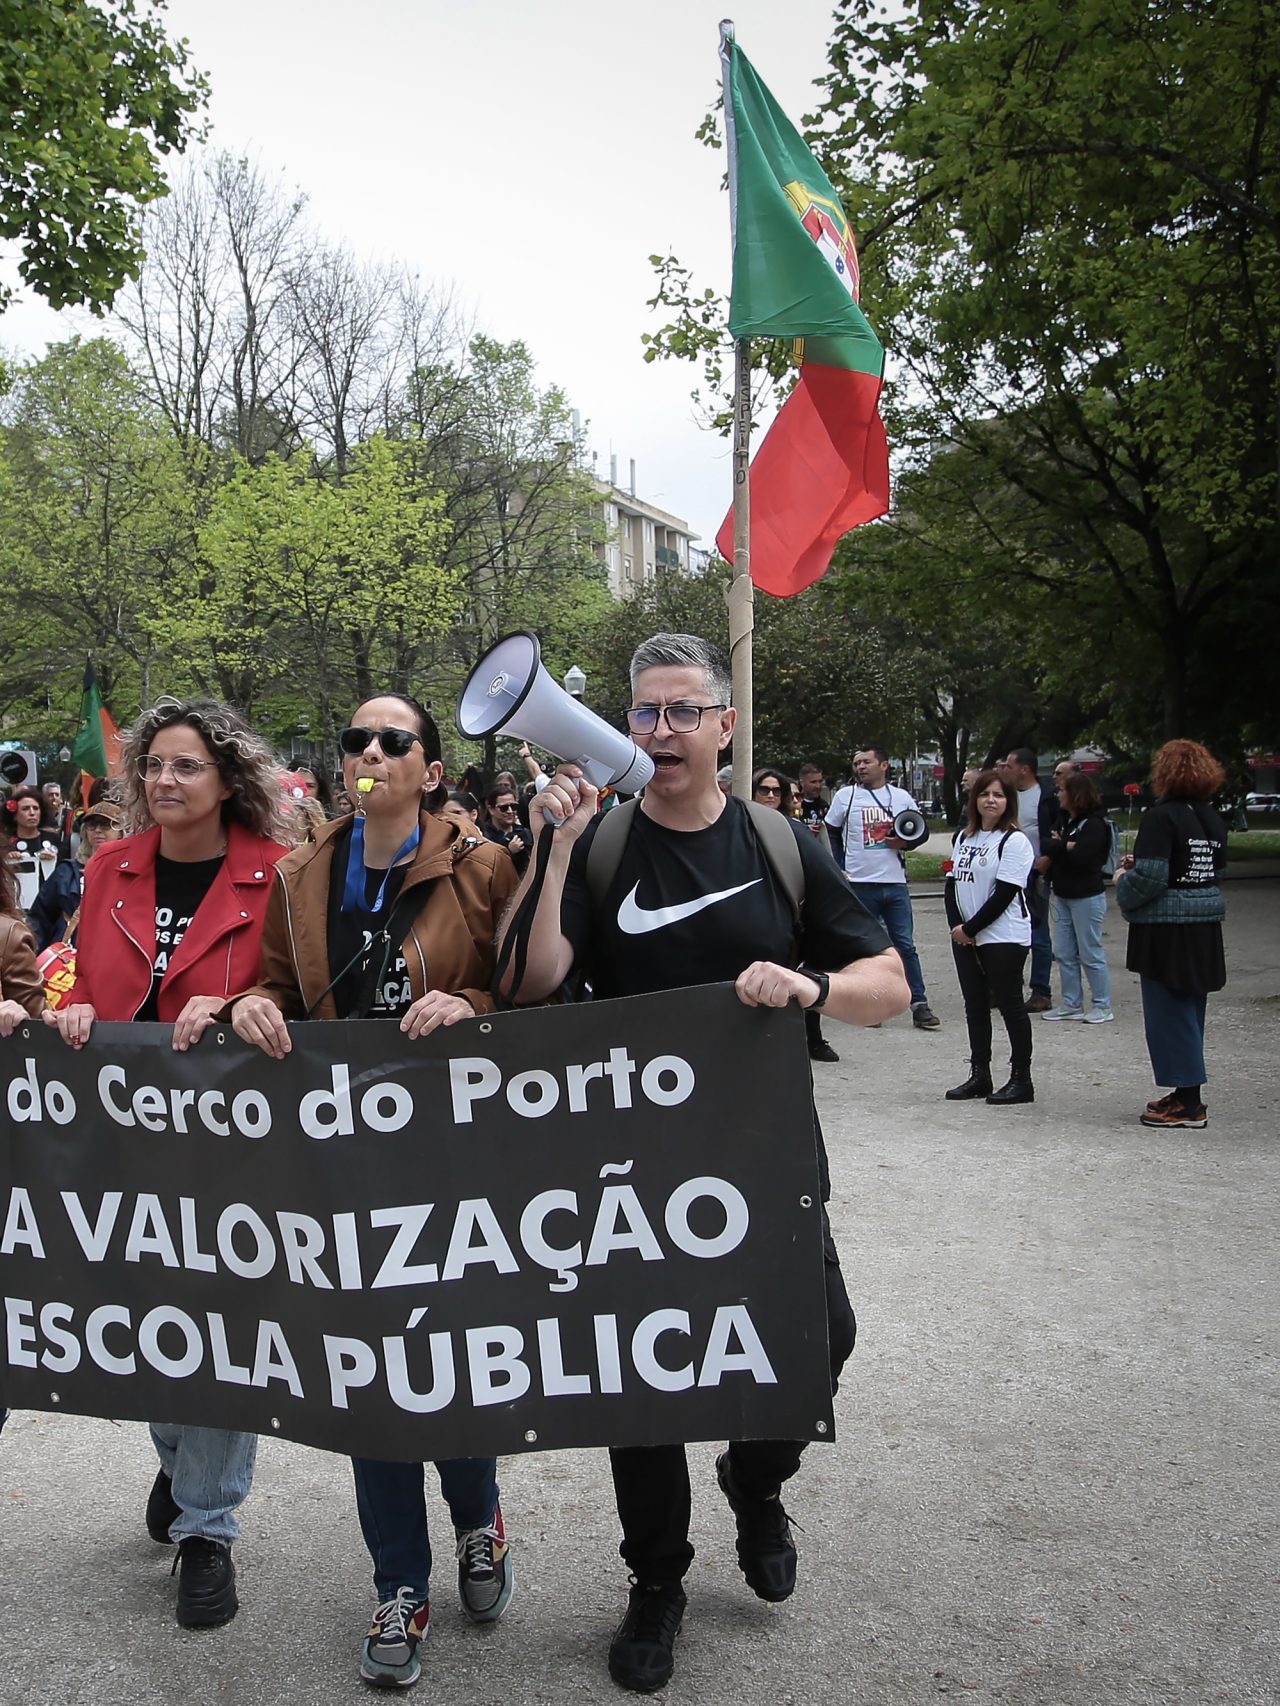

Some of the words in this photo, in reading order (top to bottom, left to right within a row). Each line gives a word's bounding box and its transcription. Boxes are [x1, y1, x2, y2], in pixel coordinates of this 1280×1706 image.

[7, 1057, 77, 1125] do
[97, 1064, 272, 1139] Cerco
[298, 1063, 414, 1140] do
[448, 1047, 695, 1124] Porto
[59, 1159, 750, 1293] VALORIZAÇÃO
[4, 1296, 305, 1399] ESCOLA
[322, 1304, 778, 1414] PÚBLICA
